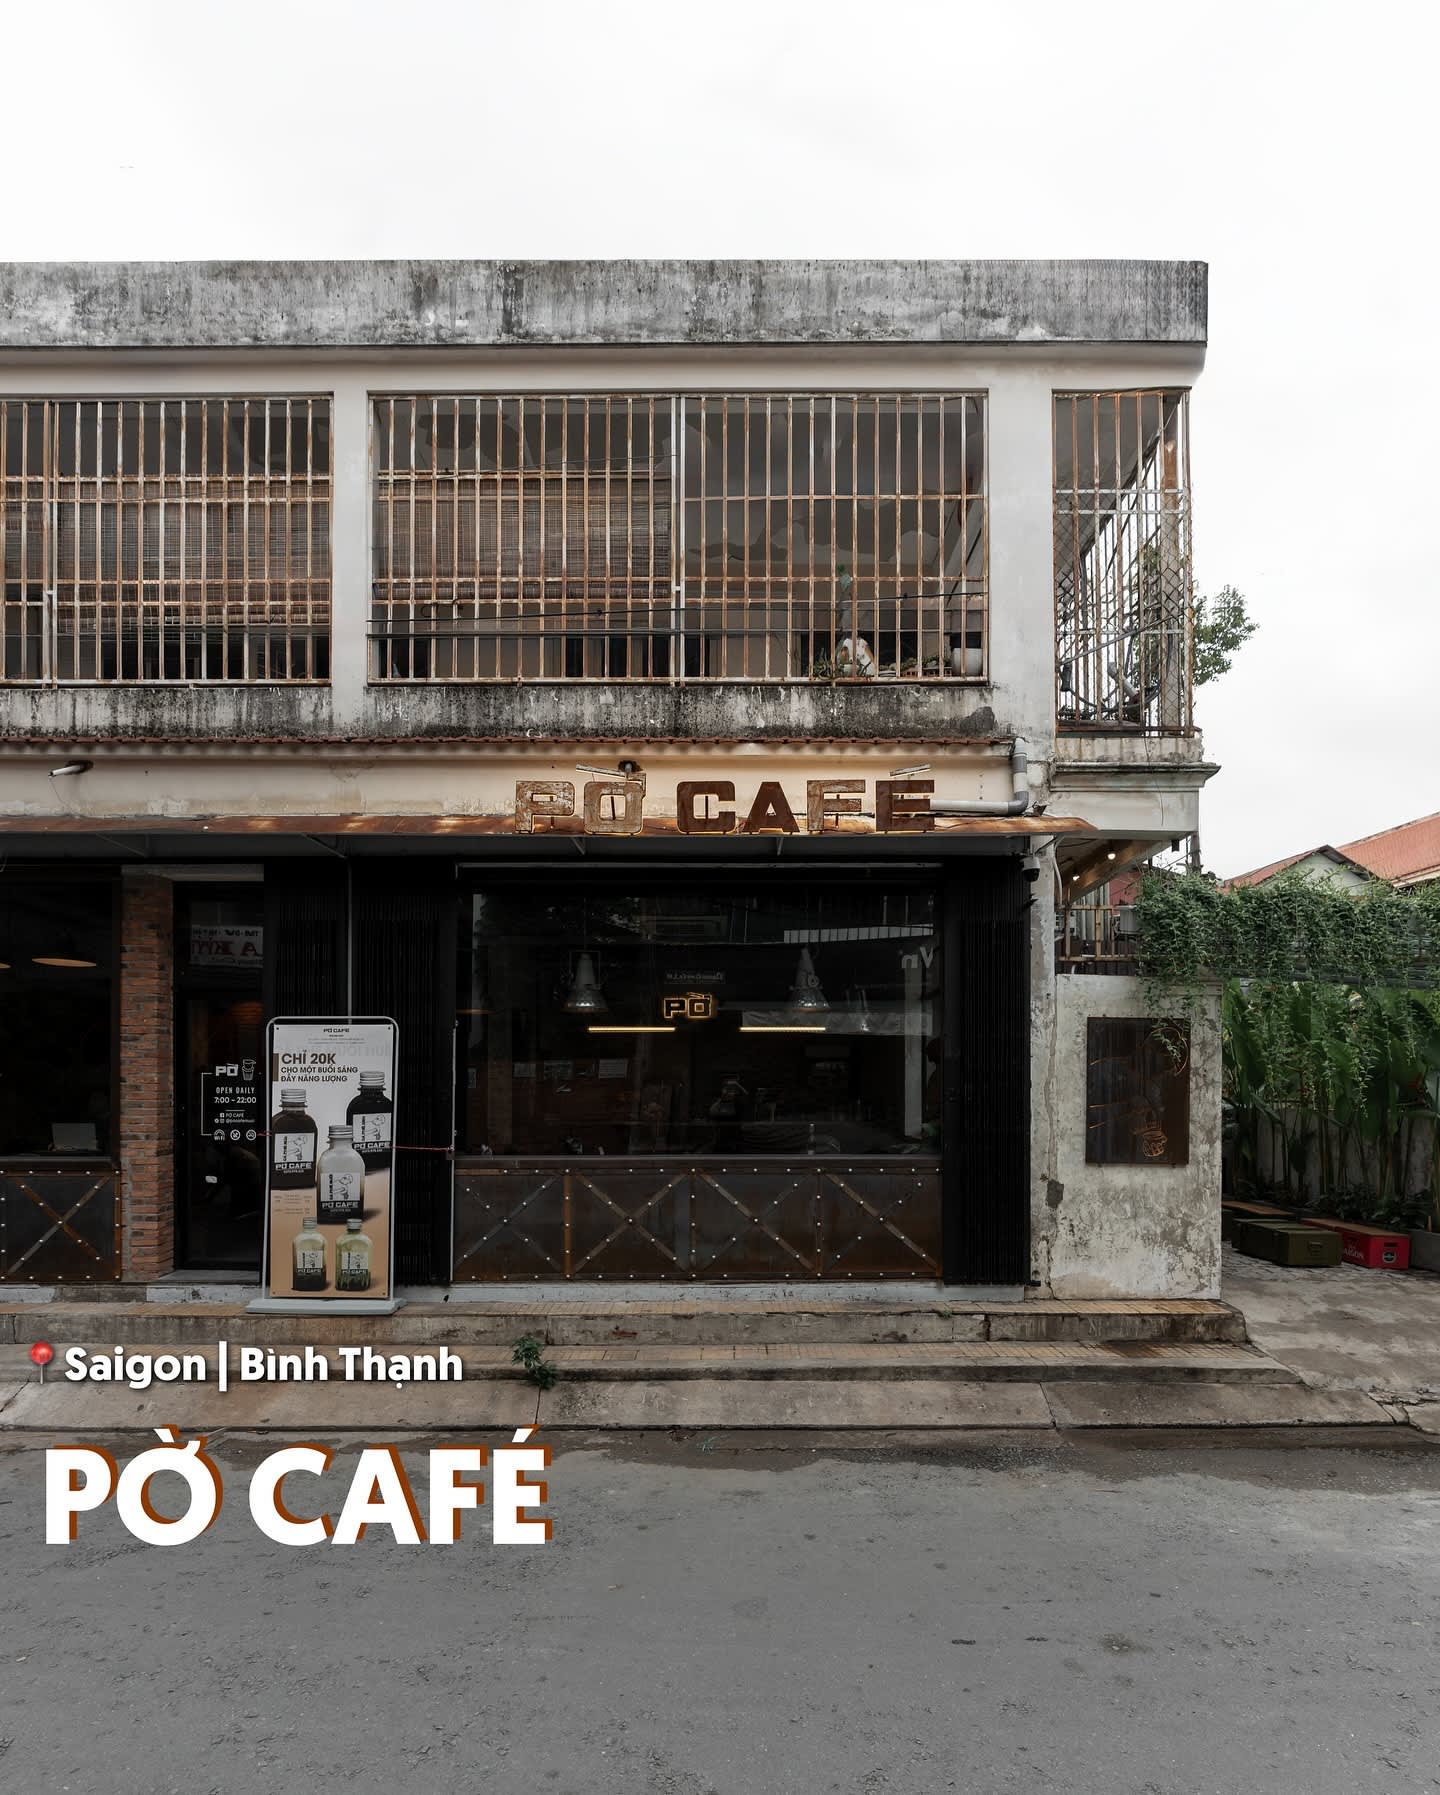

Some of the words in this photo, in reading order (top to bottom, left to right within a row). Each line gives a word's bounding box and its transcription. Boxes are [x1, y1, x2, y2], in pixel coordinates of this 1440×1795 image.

[310, 1053, 336, 1065] 20K
[299, 1066, 316, 1075] MỘT
[337, 1065, 358, 1074] SÁNG
[322, 1075, 348, 1084] LƯỢNG
